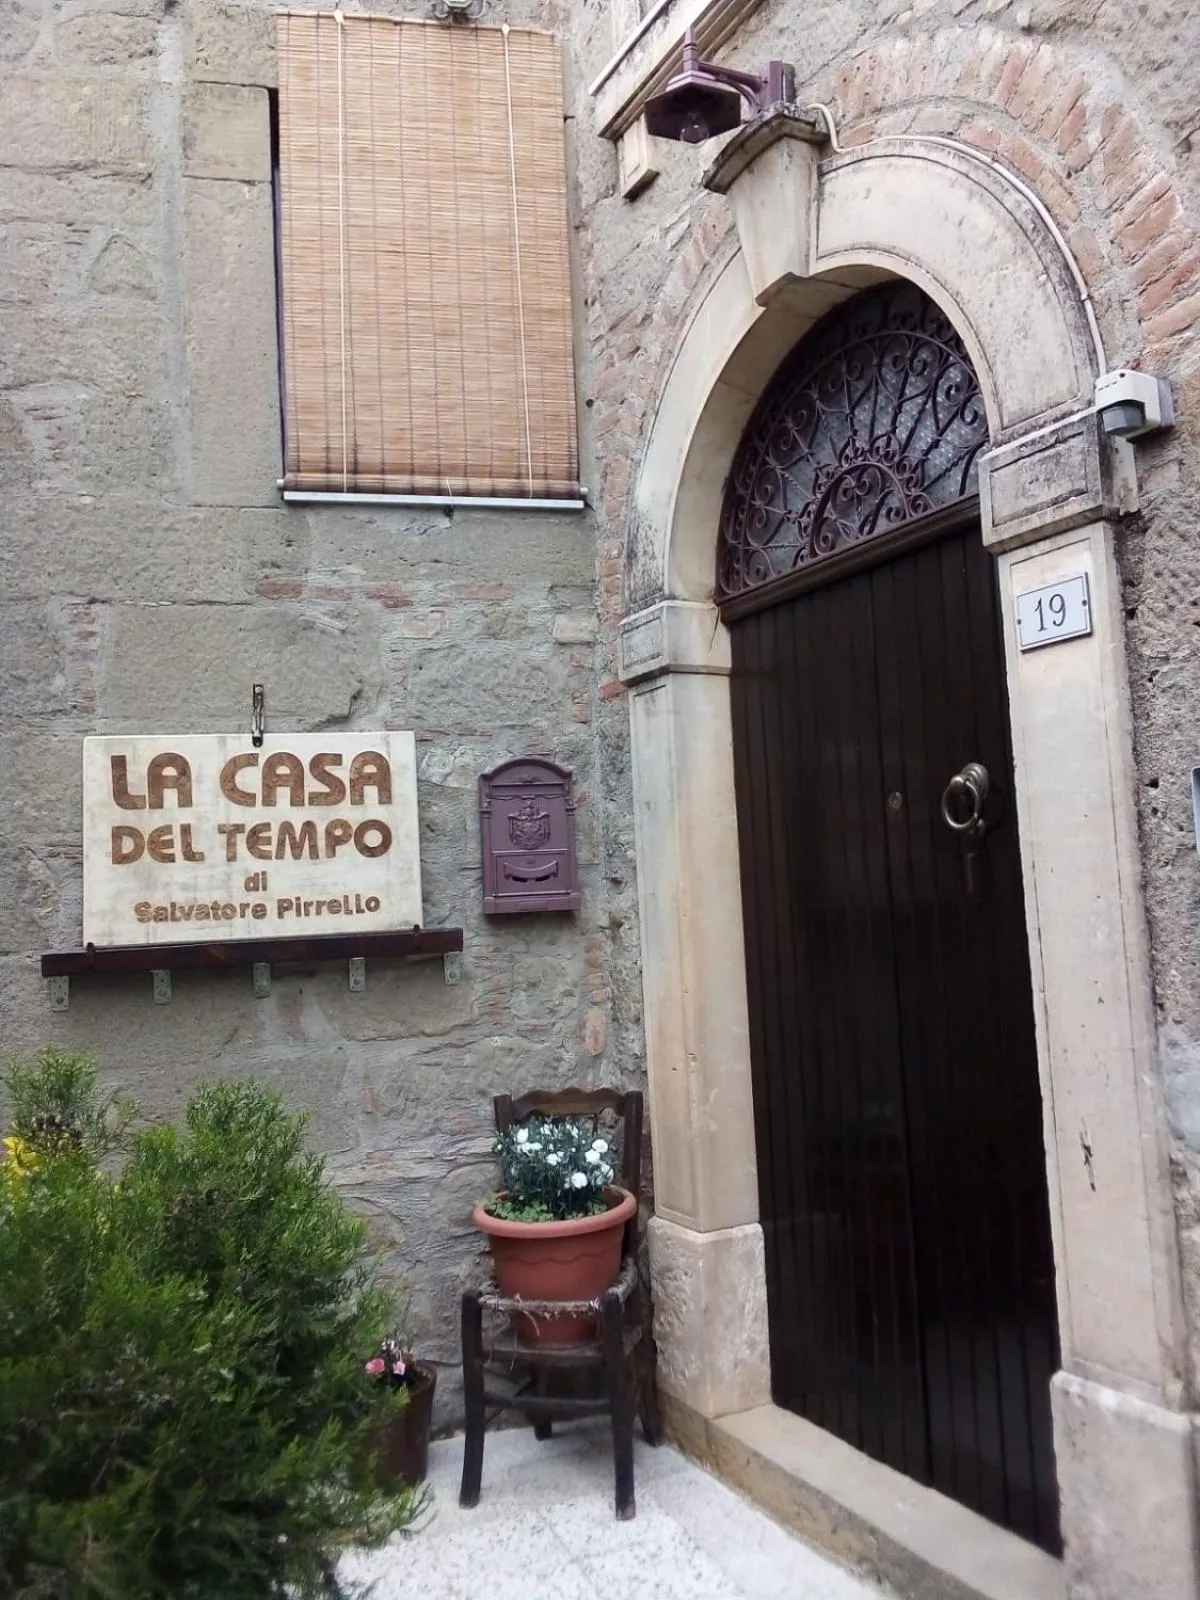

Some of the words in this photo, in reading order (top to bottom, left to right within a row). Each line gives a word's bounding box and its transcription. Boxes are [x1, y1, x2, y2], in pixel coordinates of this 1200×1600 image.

[1034, 593, 1067, 632] 19
[110, 752, 193, 809] LA
[219, 750, 392, 807] CASA
[111, 823, 205, 864] DEL
[218, 818, 392, 862] TEMPO
[243, 871, 268, 893] di
[134, 899, 267, 923] Salvatore
